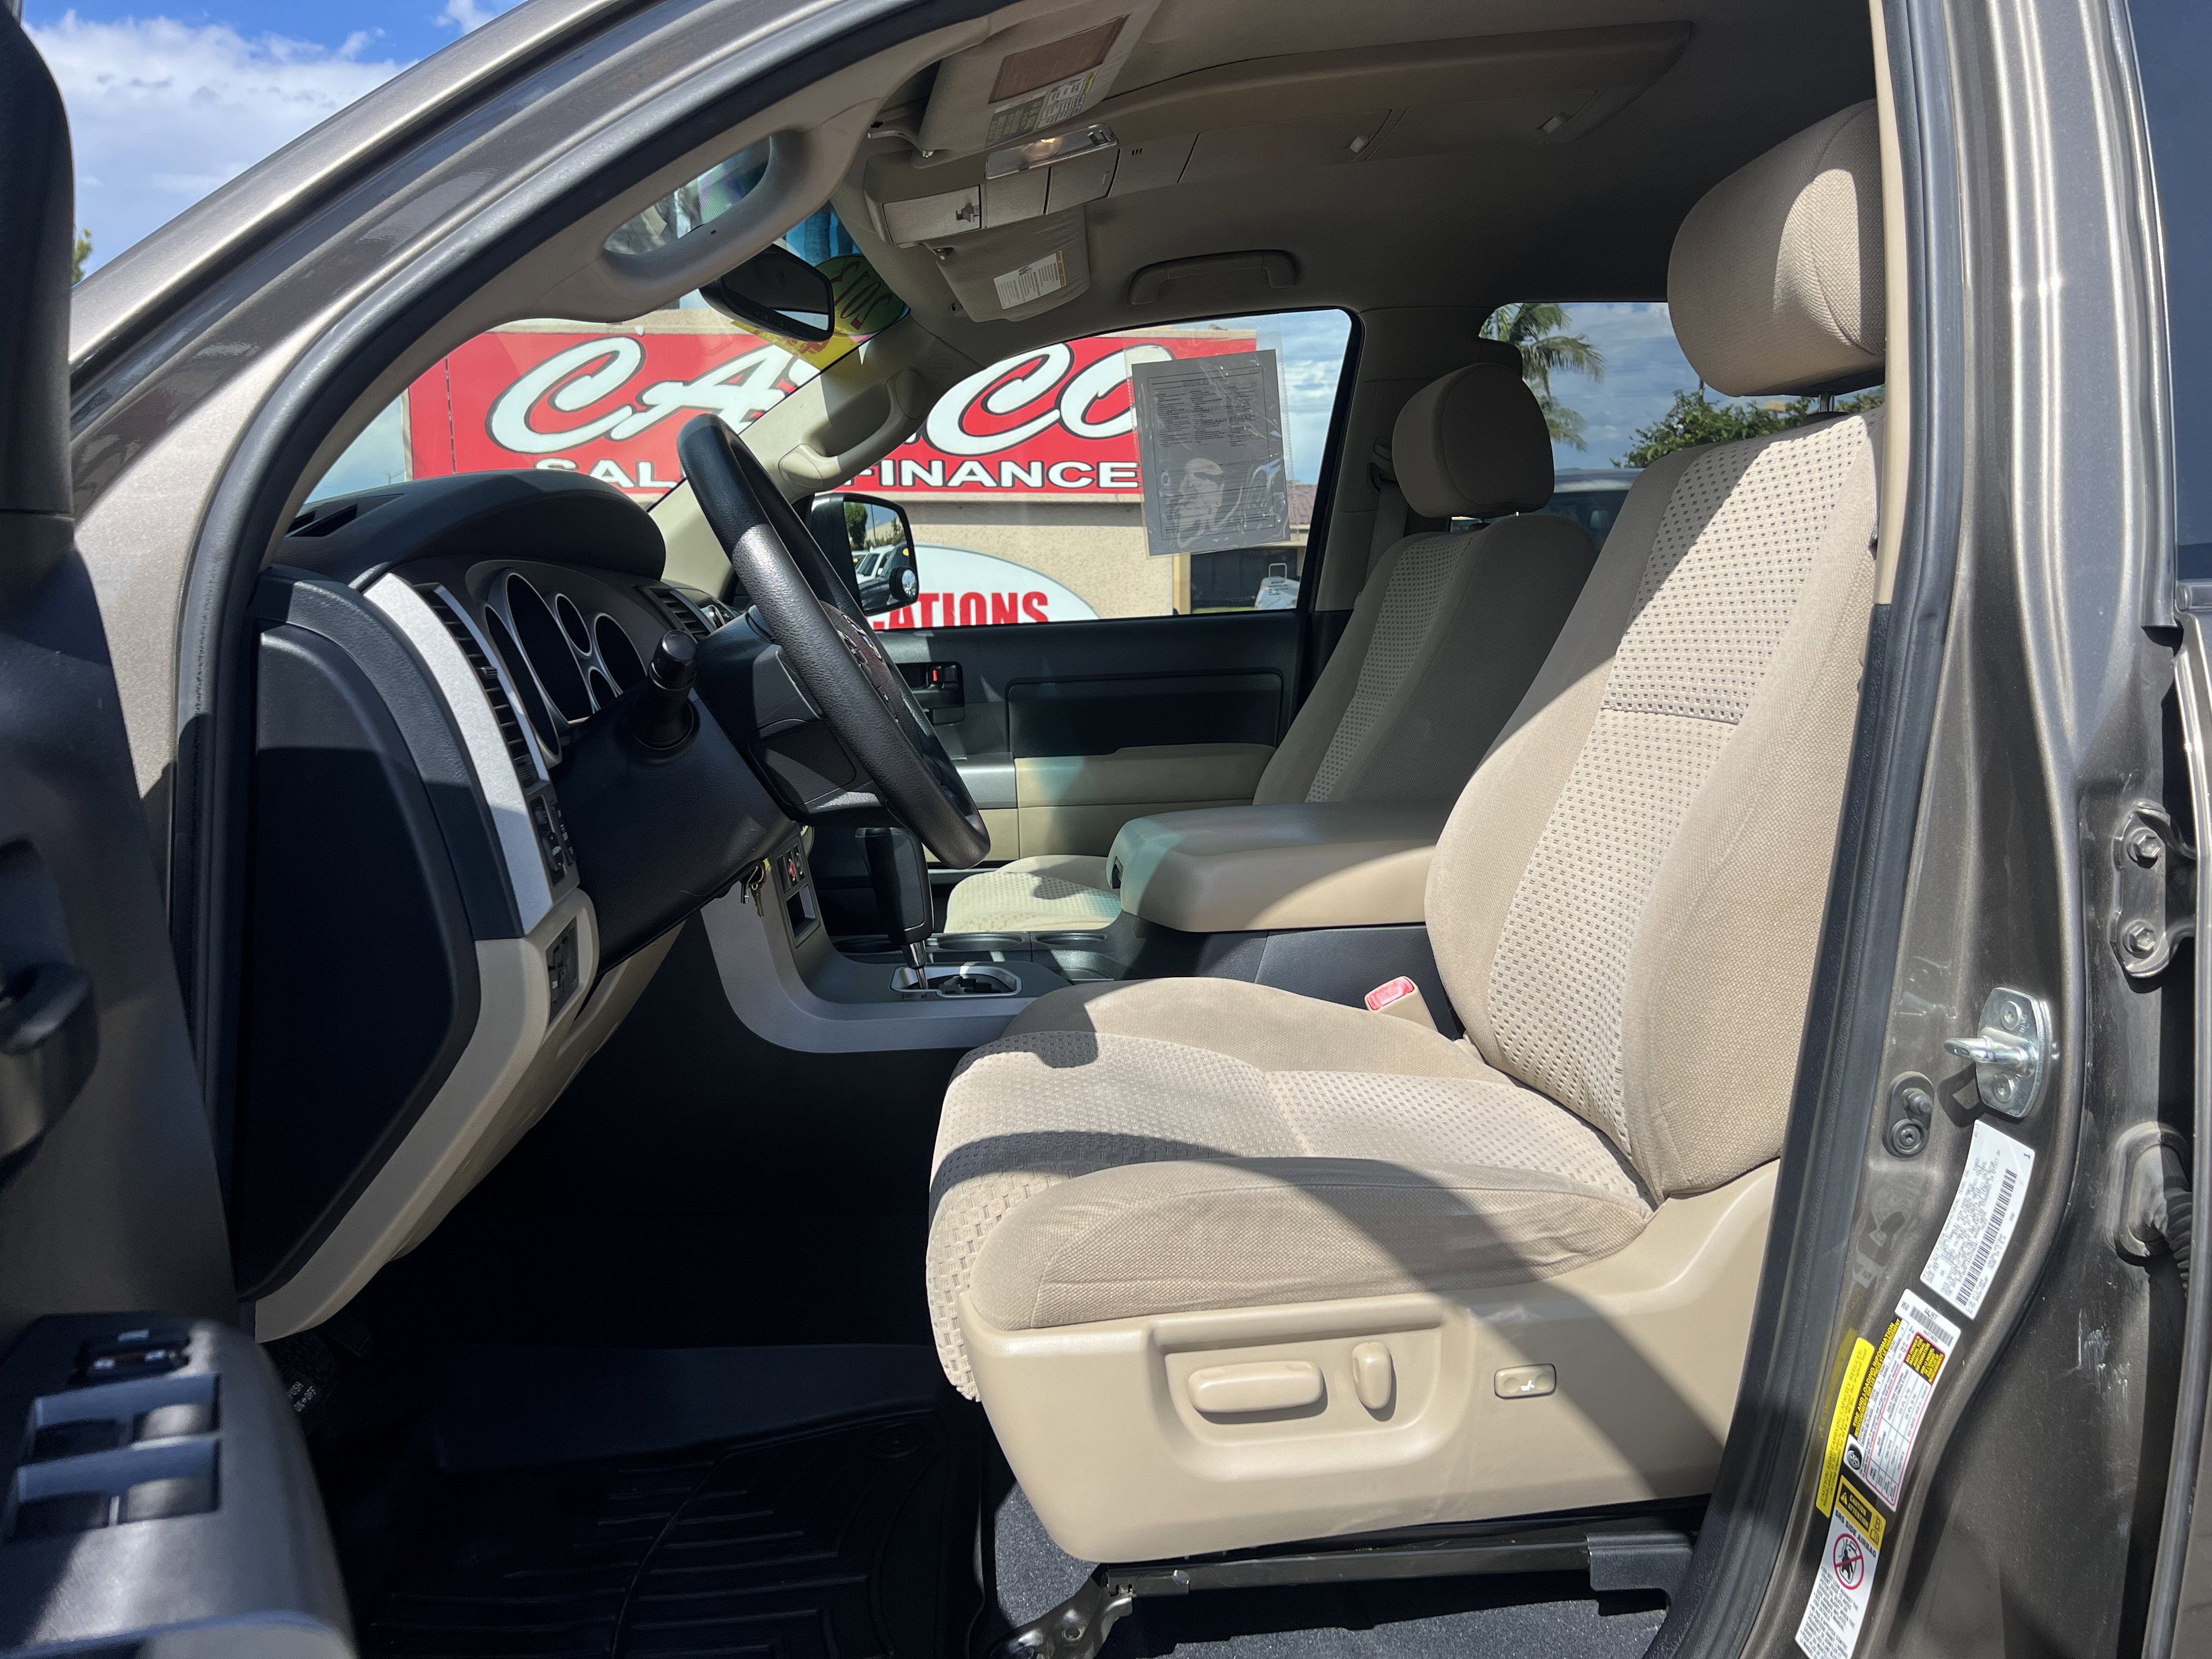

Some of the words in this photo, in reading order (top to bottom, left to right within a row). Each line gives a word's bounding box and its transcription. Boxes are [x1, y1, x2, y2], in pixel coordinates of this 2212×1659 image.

[873, 591, 1049, 629] ATIONS
[1861, 1366, 1875, 1396] LOADING
[1871, 1322, 1894, 1366] INFORMATION
[1833, 1509, 1847, 1524] SRS
[1844, 1521, 1858, 1536] SIDE
[1856, 1534, 1878, 1558] AIRBAG
